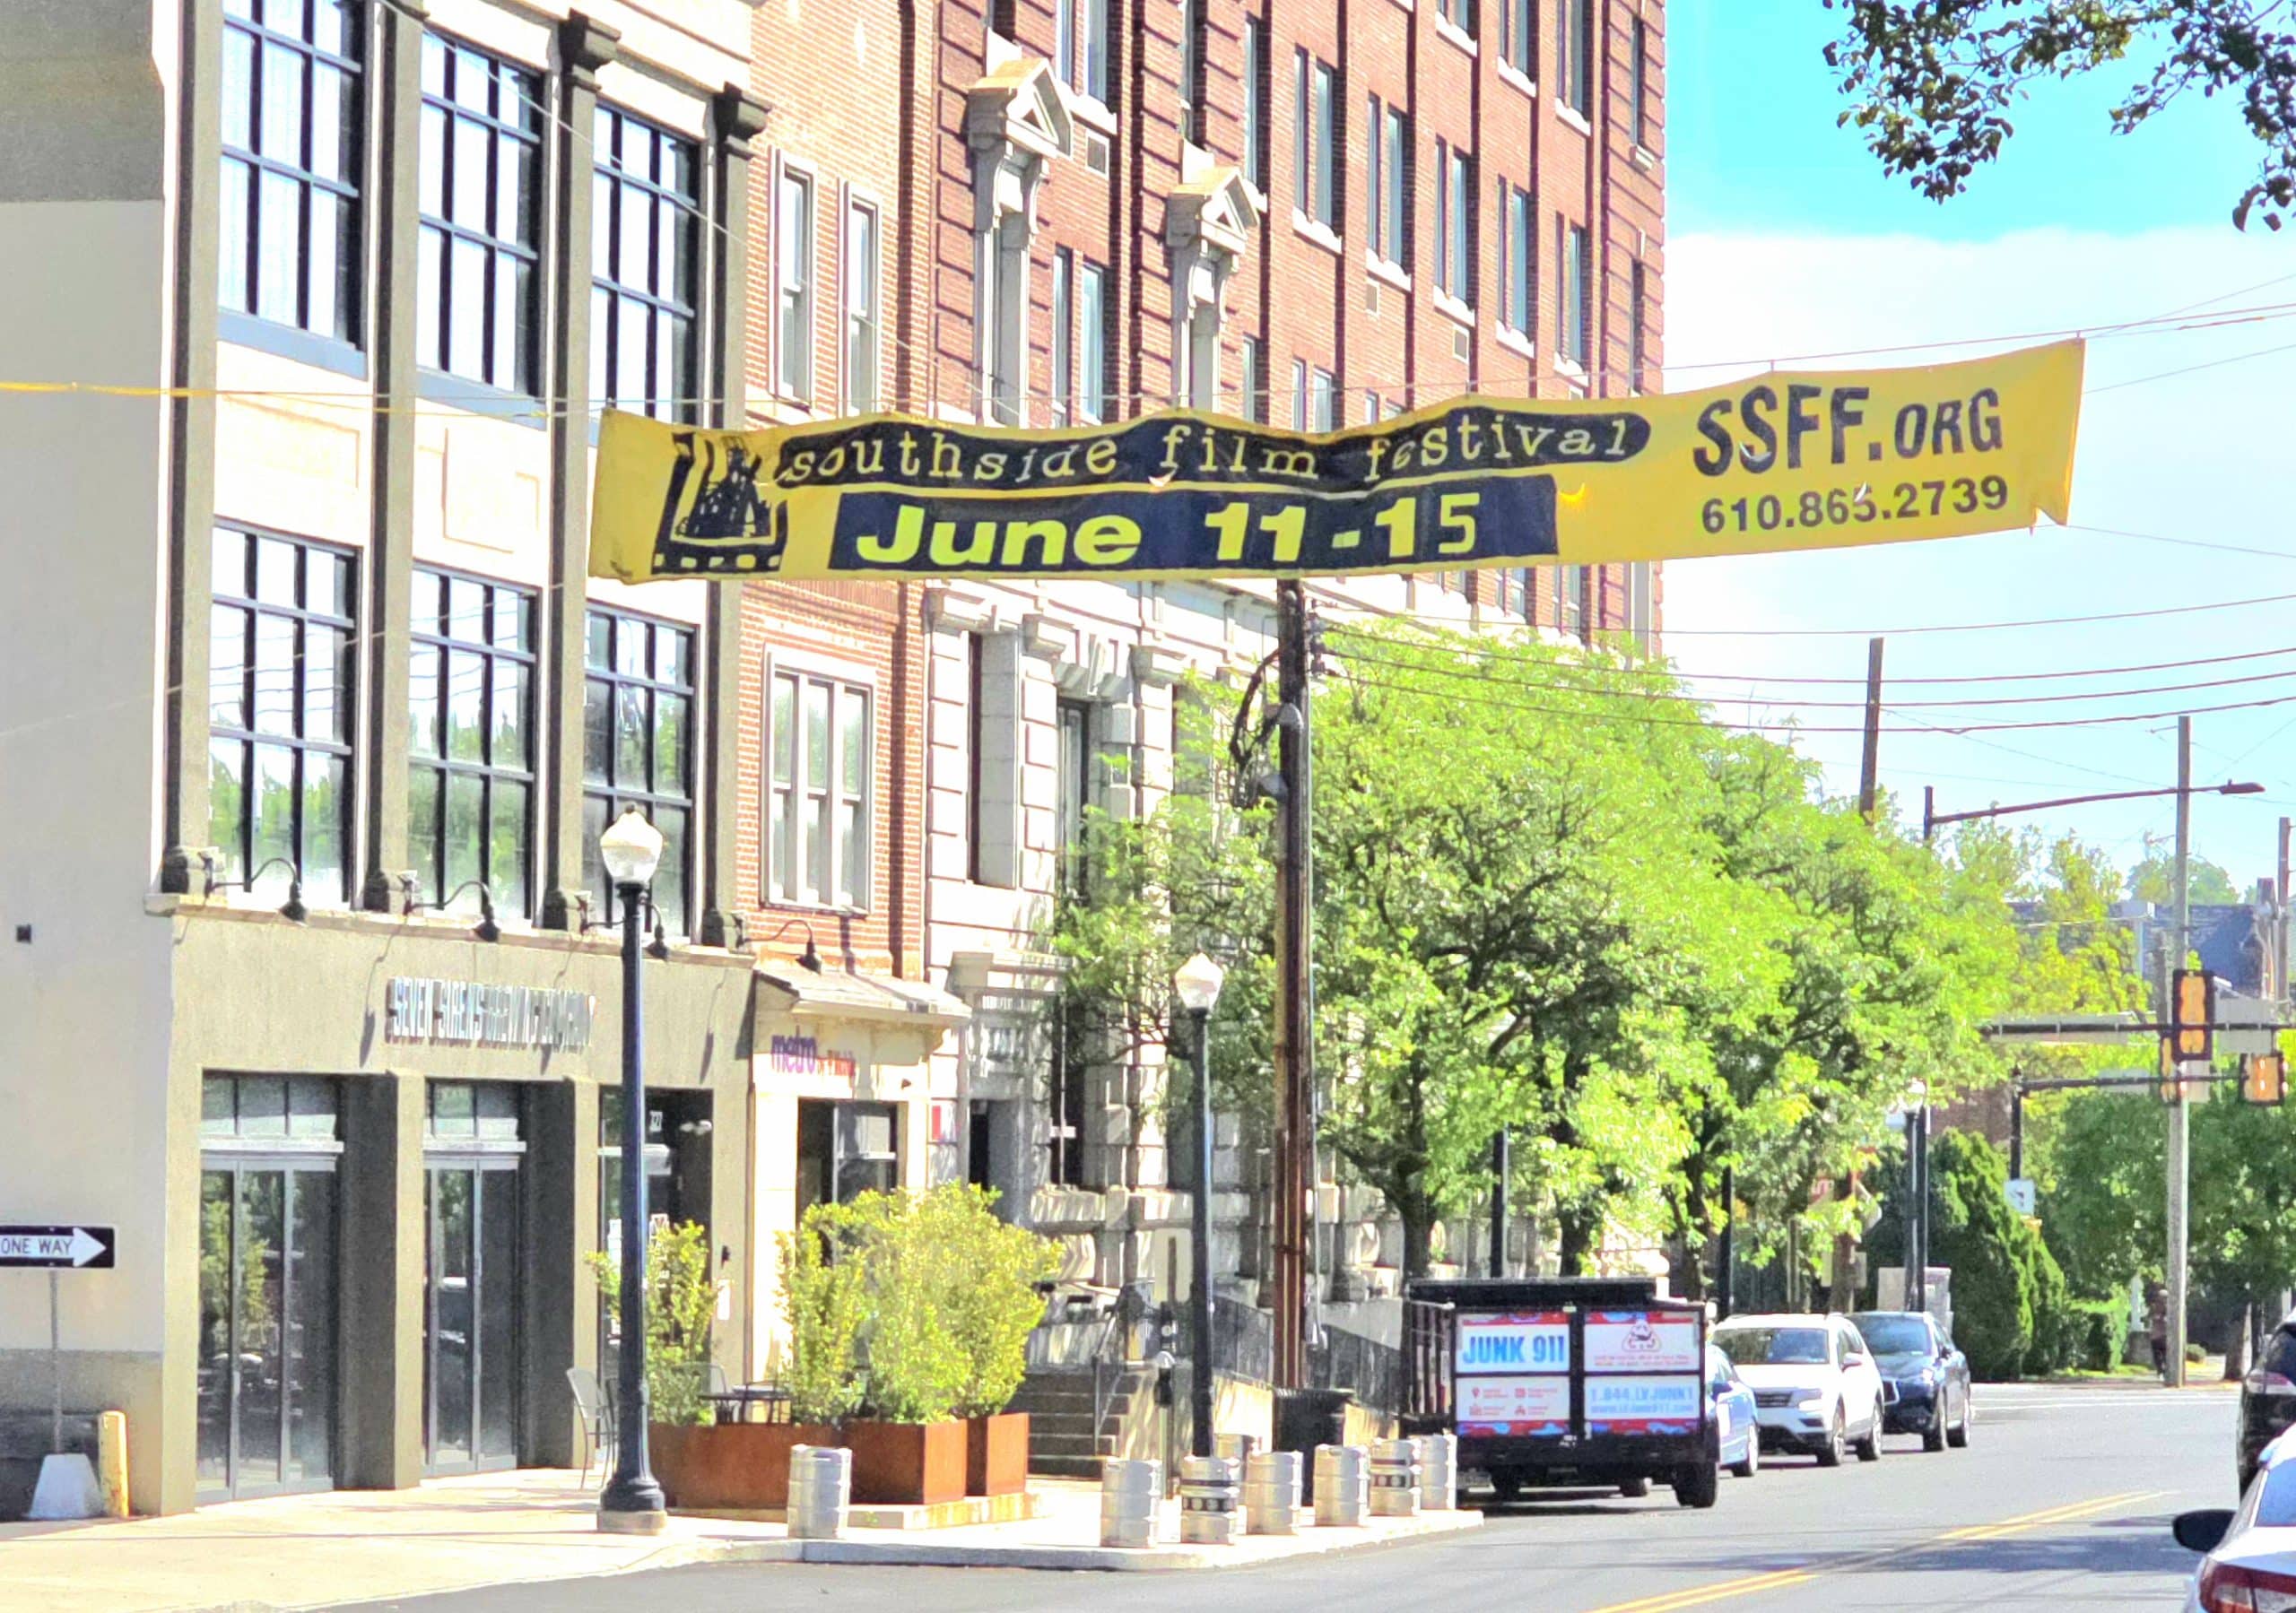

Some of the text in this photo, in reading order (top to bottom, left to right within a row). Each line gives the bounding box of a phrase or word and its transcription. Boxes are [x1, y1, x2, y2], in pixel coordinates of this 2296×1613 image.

[784, 412, 1628, 484] southside film festival
[1692, 384, 2003, 477] SSFF.ORG
[1701, 474, 2008, 534] 610.865.2739
[856, 506, 1143, 567] June
[1, 1237, 73, 1254] ONE WAY
[1462, 1334, 1565, 1364] JUNK 911
